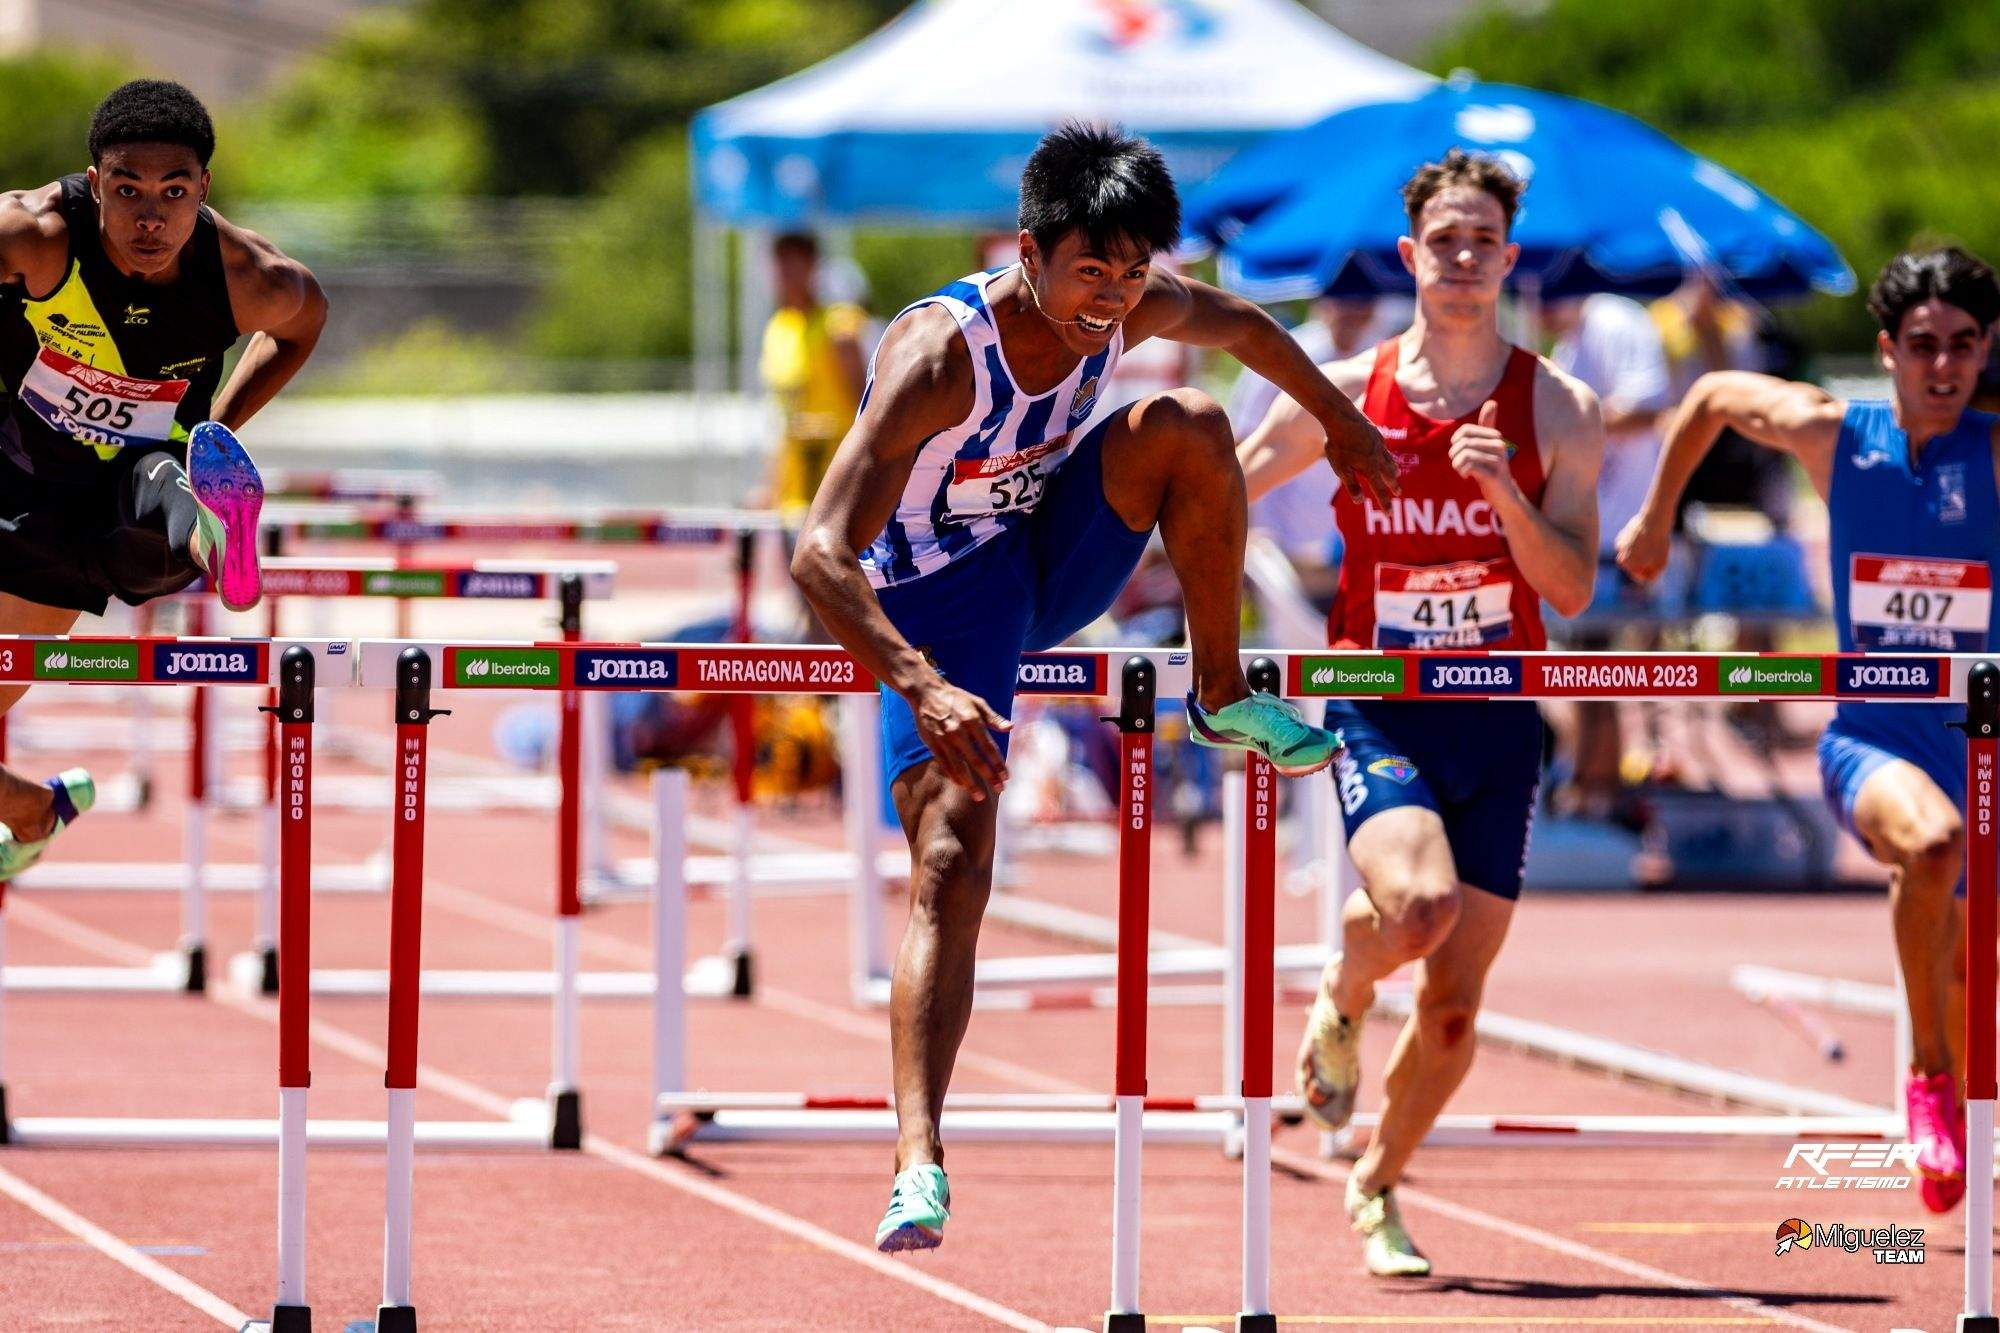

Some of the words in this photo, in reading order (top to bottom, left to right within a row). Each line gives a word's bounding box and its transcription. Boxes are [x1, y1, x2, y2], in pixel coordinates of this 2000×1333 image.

[61, 385, 138, 430] 505
[990, 462, 1045, 509] 525
[1413, 595, 1480, 627] 414
[1885, 591, 1954, 622] 407
[70, 655, 130, 669] Iberdrola
[491, 662, 551, 676] Iberdrola
[697, 659, 804, 683] TARRAGONA
[809, 660, 854, 683] 2023
[1016, 663, 1086, 684] oma
[1336, 670, 1395, 684] Iberdrola
[1541, 665, 1648, 688] TARRAGONA
[1652, 664, 1698, 688] 2023
[1754, 669, 1812, 683] Iberdrola
[290, 752, 305, 820] MONDO
[404, 753, 420, 821] MONDO
[1131, 762, 1146, 830] MONDO
[1255, 763, 1270, 831] MONDO
[1977, 768, 1993, 836] MONDO
